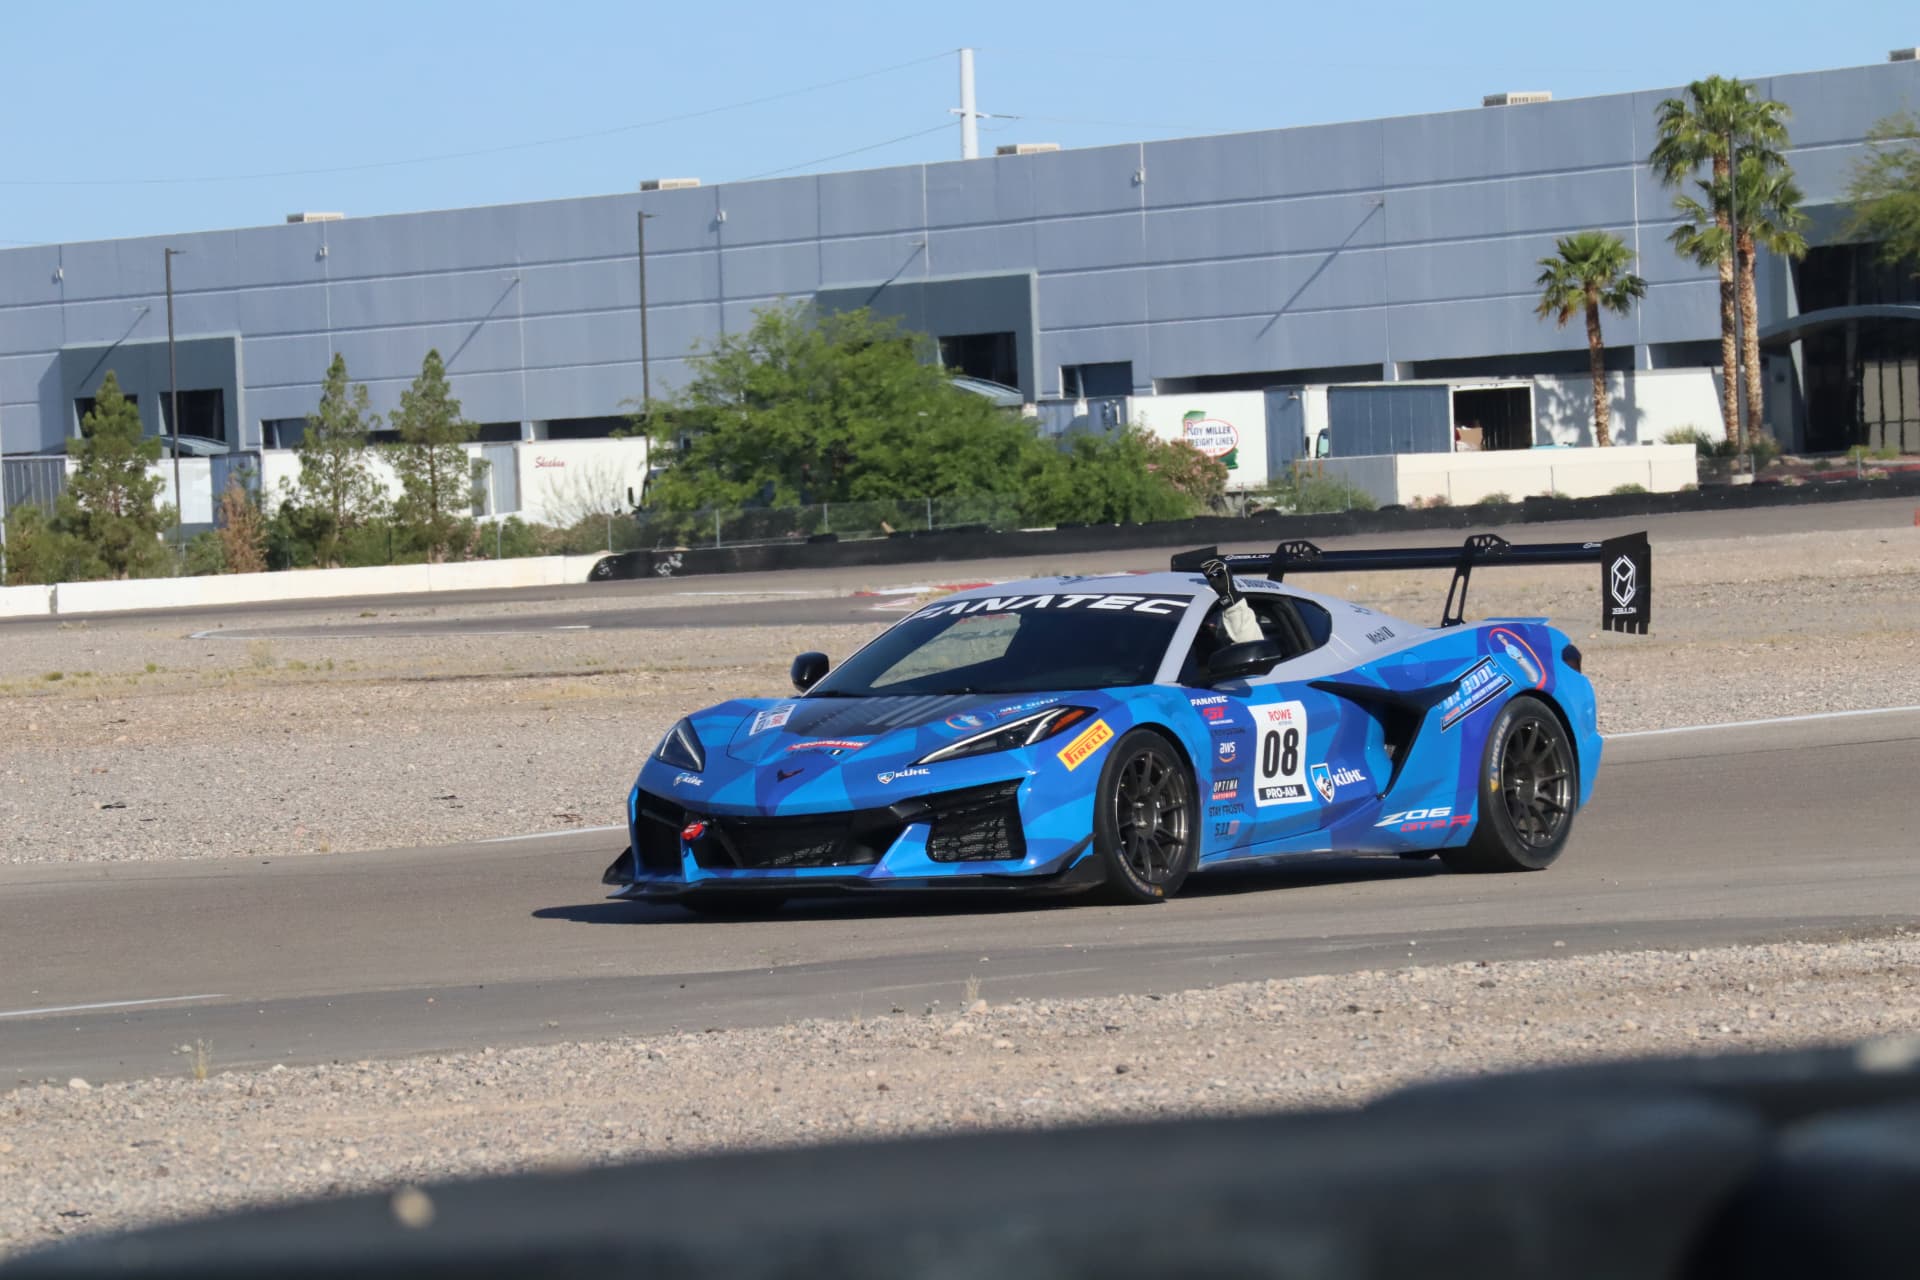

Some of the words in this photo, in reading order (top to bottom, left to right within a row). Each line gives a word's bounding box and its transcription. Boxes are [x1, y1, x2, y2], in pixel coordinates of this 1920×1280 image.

[1186, 421, 1202, 436] ROY
[1206, 426, 1231, 435] MILLER
[1216, 437, 1234, 446] LINES
[910, 594, 1190, 622] FANATEC
[1460, 665, 1497, 696] COOL
[1190, 696, 1228, 706] FANATEC
[1268, 709, 1292, 721] ROWE
[1063, 724, 1108, 765] PIRELLI
[1219, 742, 1236, 754] aws
[1262, 727, 1299, 779] 08
[1332, 767, 1366, 787] KÜHL
[1213, 779, 1238, 793] OPTIMA
[1265, 786, 1298, 799] PRO-AM
[1373, 807, 1452, 827] Z06
